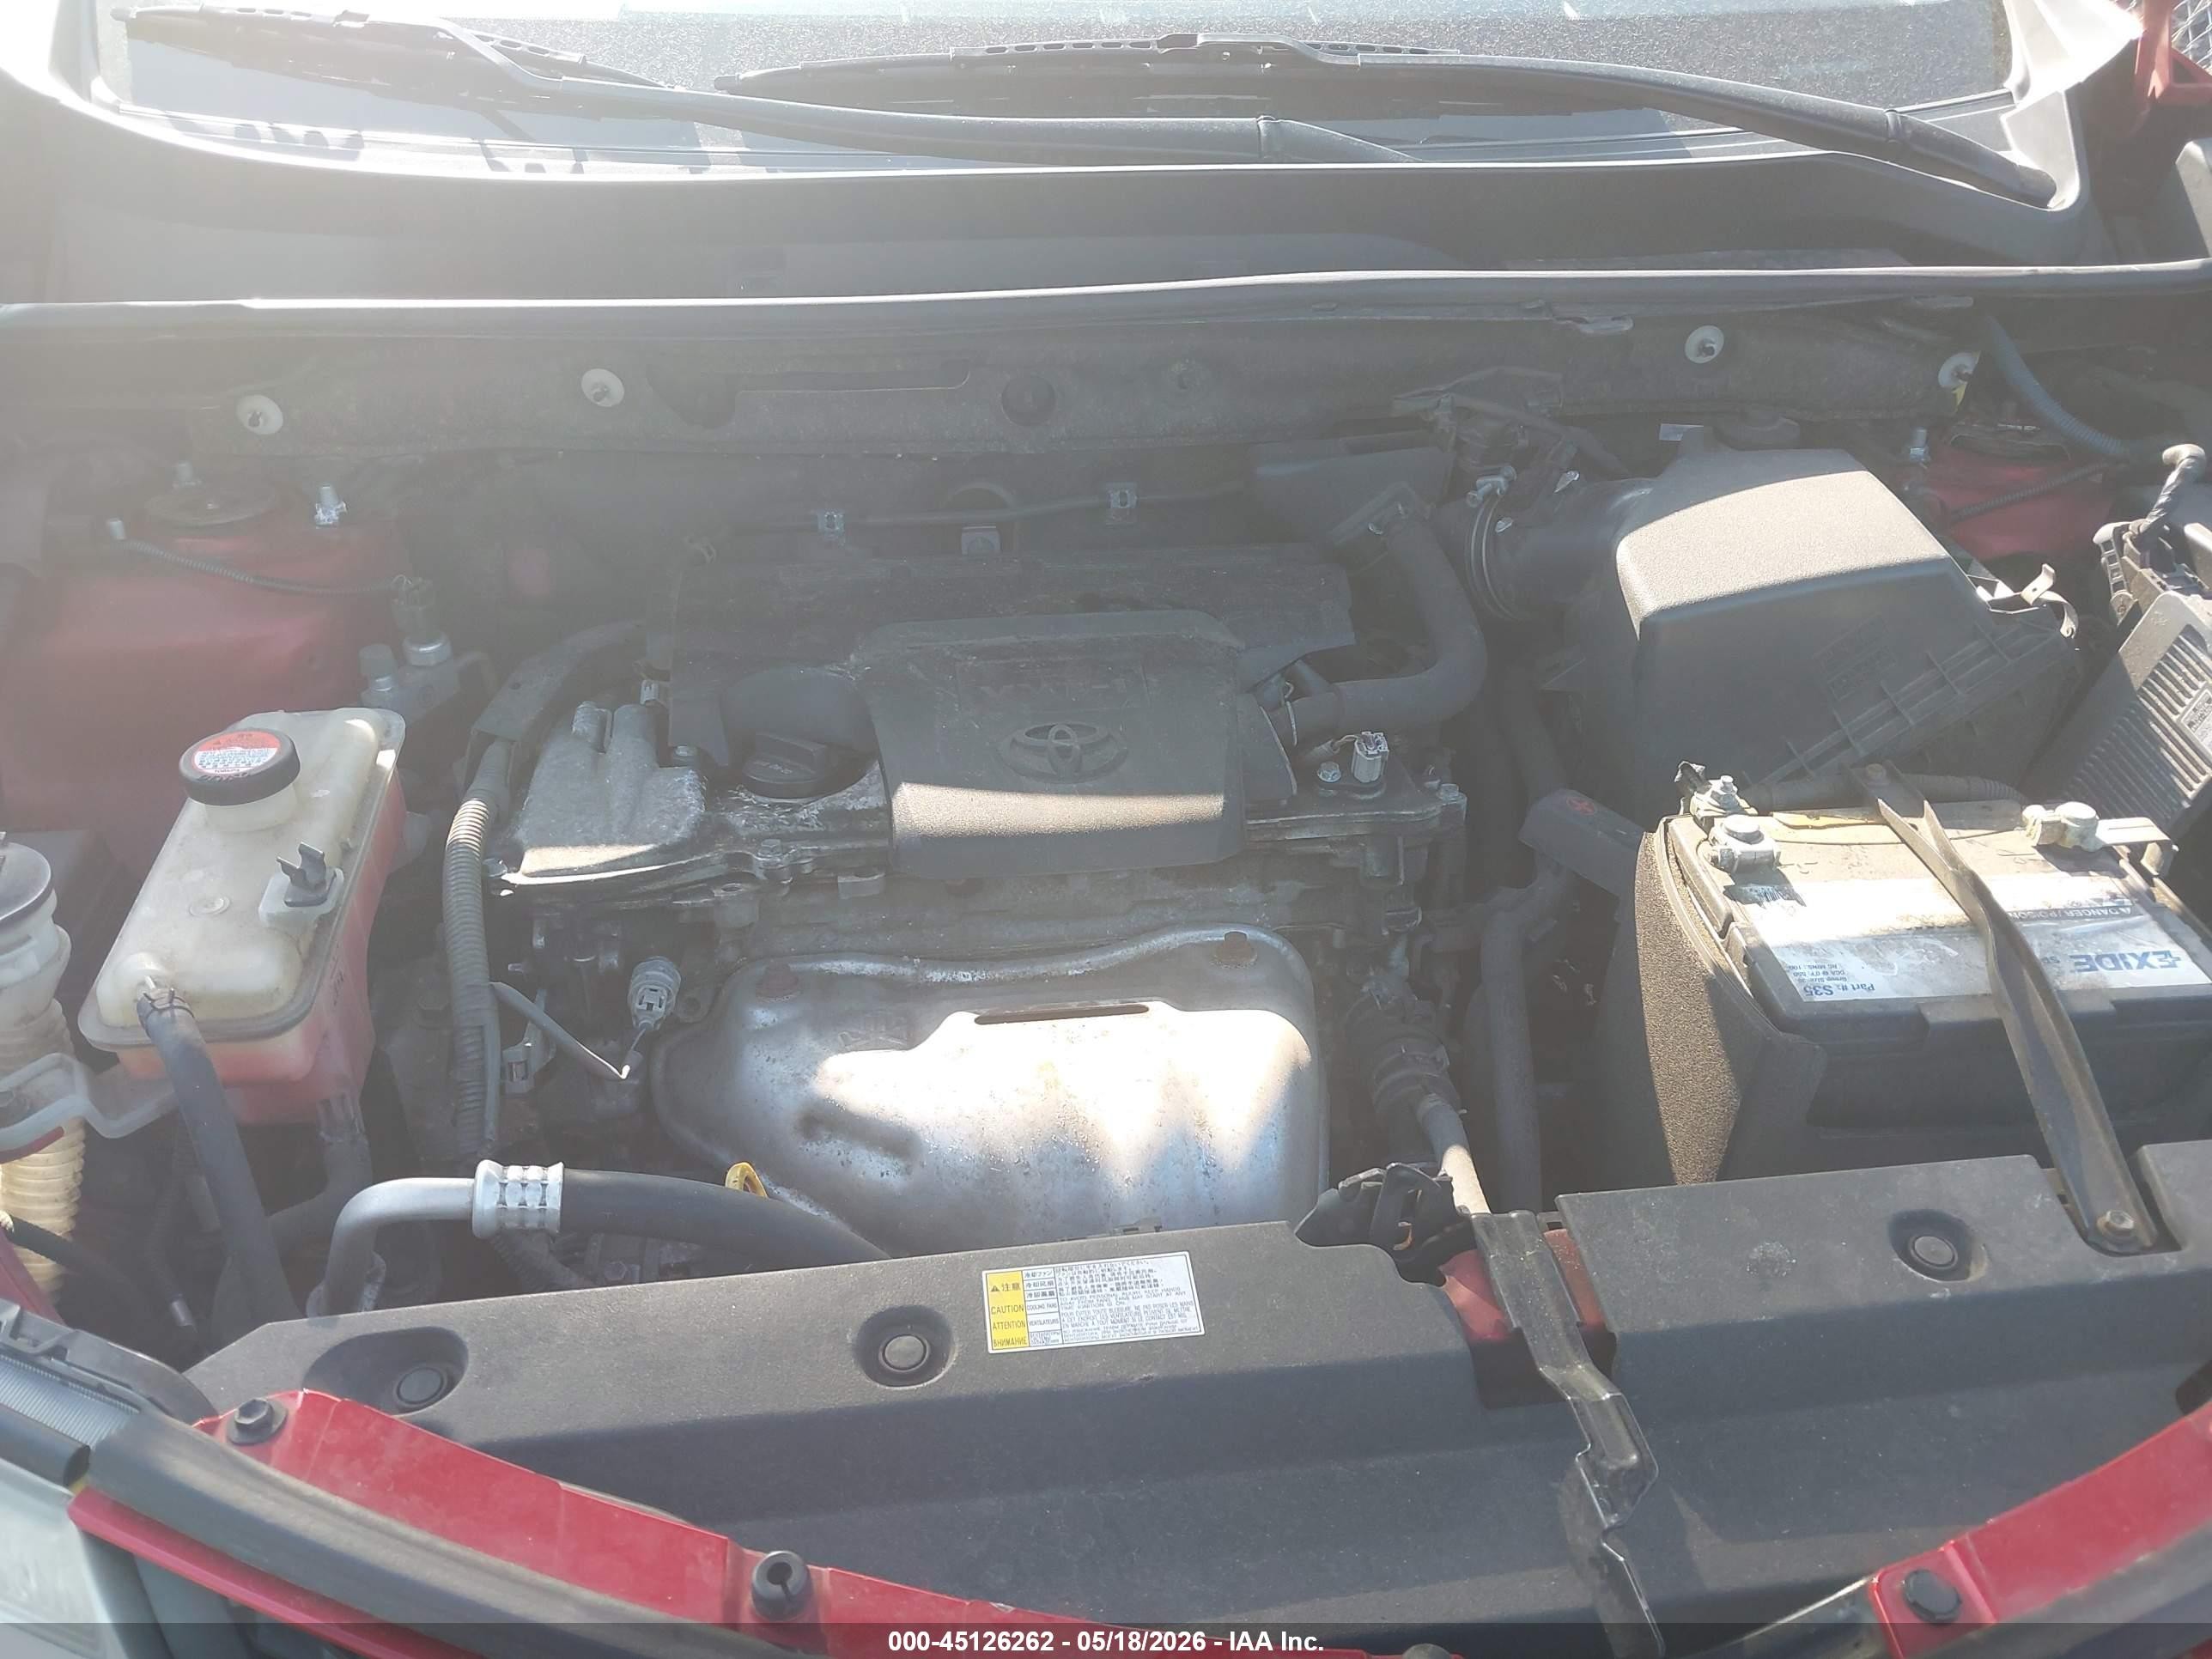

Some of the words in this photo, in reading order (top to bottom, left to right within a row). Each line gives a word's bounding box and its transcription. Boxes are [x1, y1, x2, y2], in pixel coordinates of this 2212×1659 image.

[2067, 907, 2121, 918] DANGER
[2069, 951, 2181, 972] EXIDE
[1803, 984, 1834, 997] S35
[990, 1304, 1024, 1315] CAUTION
[992, 1319, 1025, 1330] ATTENTION
[993, 1337, 1027, 1347] ВНИМАНИЕ
